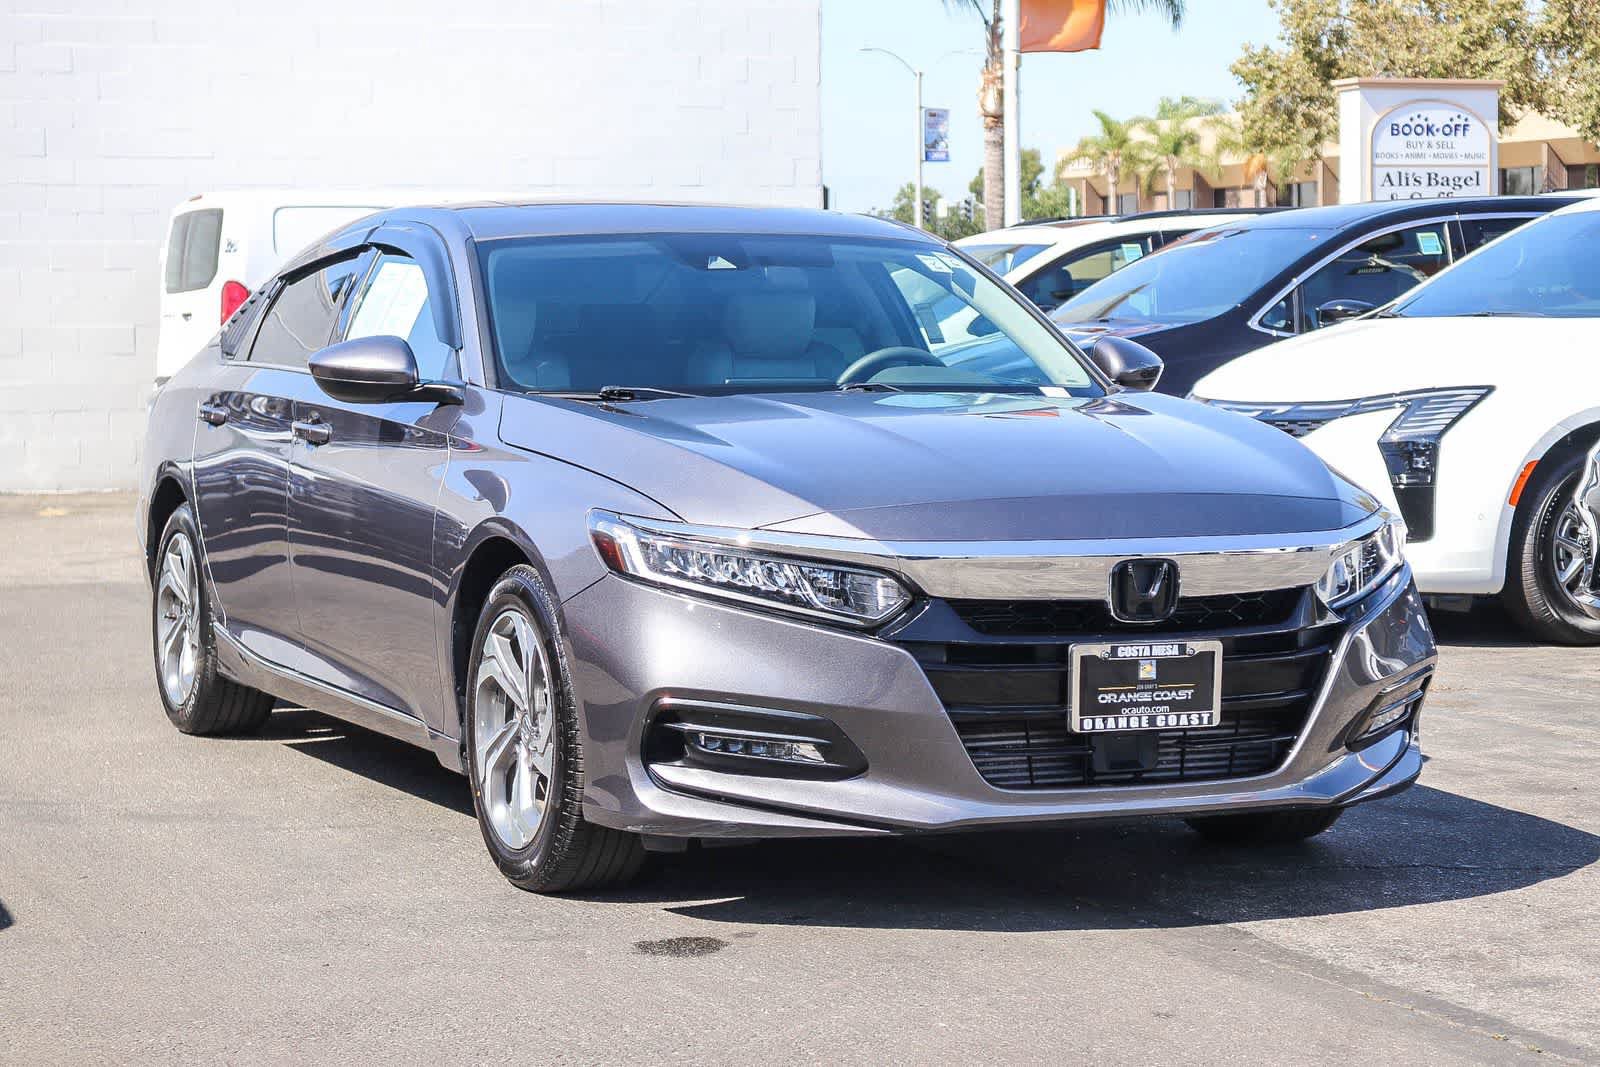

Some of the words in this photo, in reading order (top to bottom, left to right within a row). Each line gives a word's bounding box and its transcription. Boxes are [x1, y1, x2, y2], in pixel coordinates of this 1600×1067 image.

[1406, 140, 1424, 150] BUY
[1426, 140, 1433, 150] &
[1435, 140, 1456, 150] SELL
[1375, 152, 1399, 160] BOOKS
[1381, 171, 1422, 187] Ali's
[1426, 171, 1480, 190] Bagel
[1117, 645, 1151, 657] COSTA
[1152, 644, 1179, 656] MESA
[1097, 691, 1152, 704] ORANGE
[1153, 689, 1195, 702] COAST
[1121, 705, 1170, 715] ocauto.com
[1083, 715, 1149, 730] ORANGE
[1156, 713, 1211, 727] COAST
